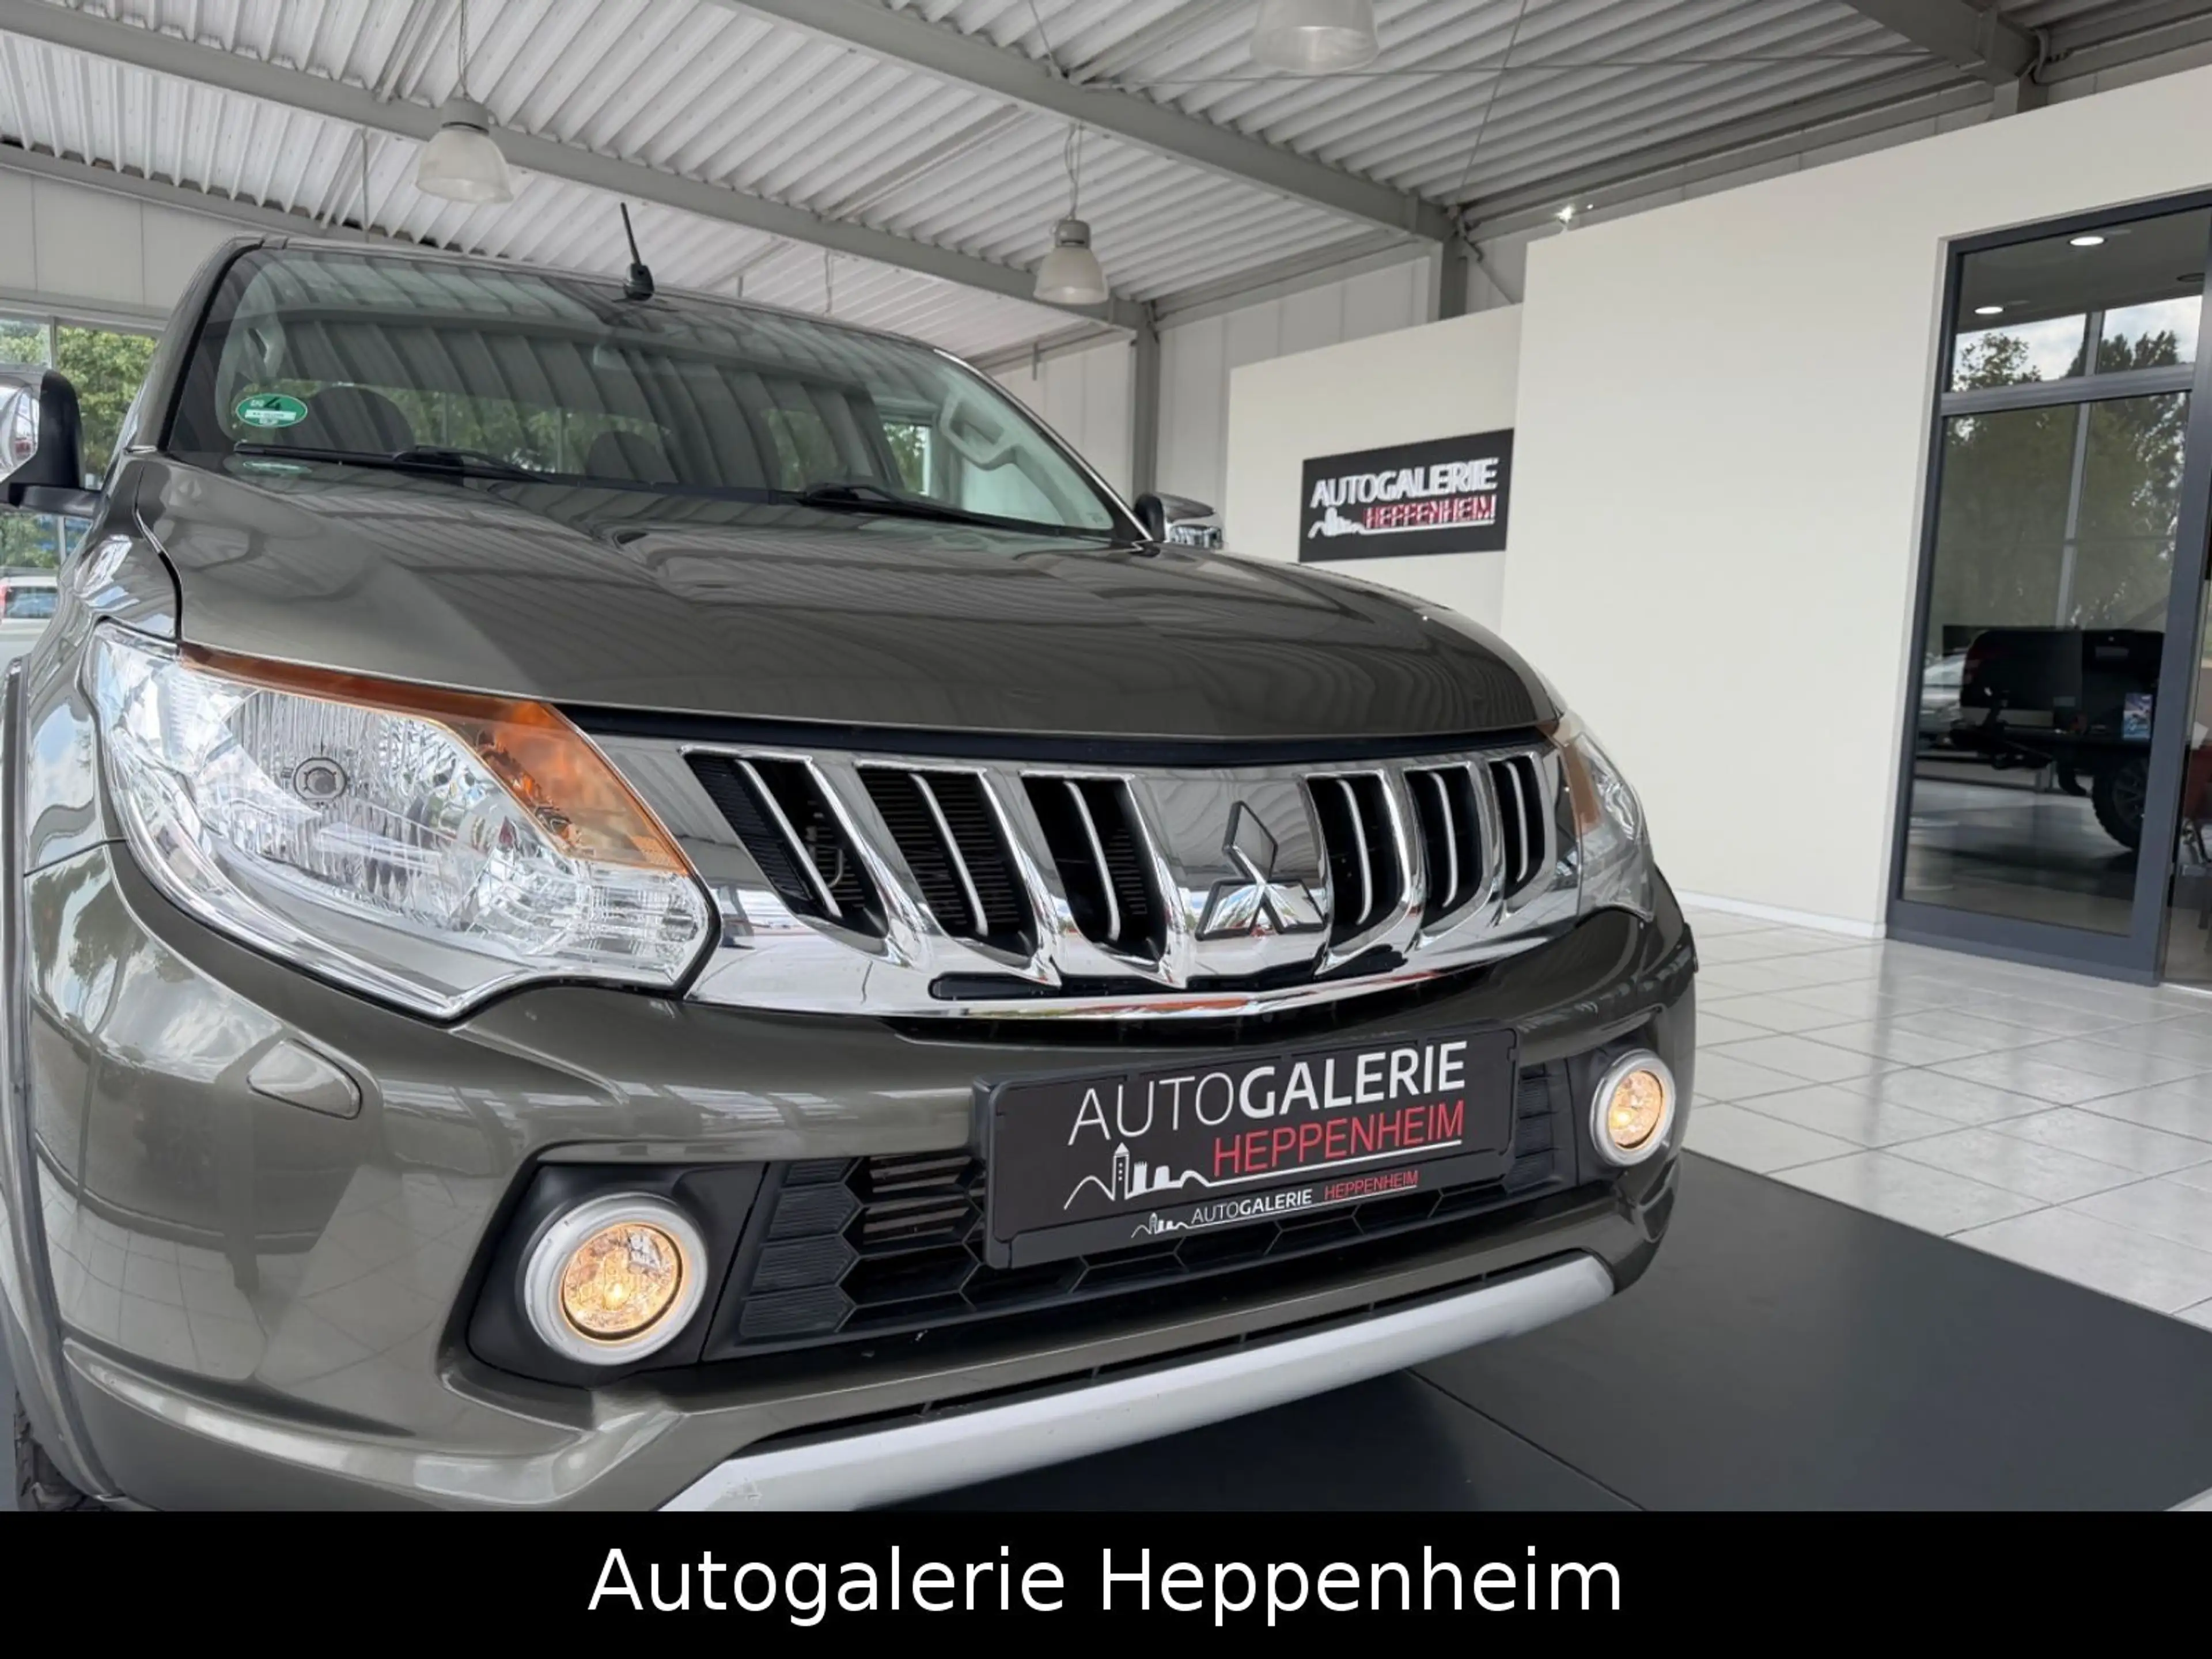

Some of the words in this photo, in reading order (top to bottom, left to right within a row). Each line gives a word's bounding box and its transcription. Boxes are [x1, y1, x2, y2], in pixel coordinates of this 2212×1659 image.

[1310, 457, 1499, 509] AUTOGALERIE
[1363, 495, 1496, 529] HEPPENHEIM
[1067, 1041, 1467, 1145] AUTOGALERIE
[1213, 1100, 1465, 1176] HEPPENHEIM
[1191, 1188, 1313, 1224] AUTOGALERIE
[1324, 1170, 1419, 1201] HEPPENHEIM
